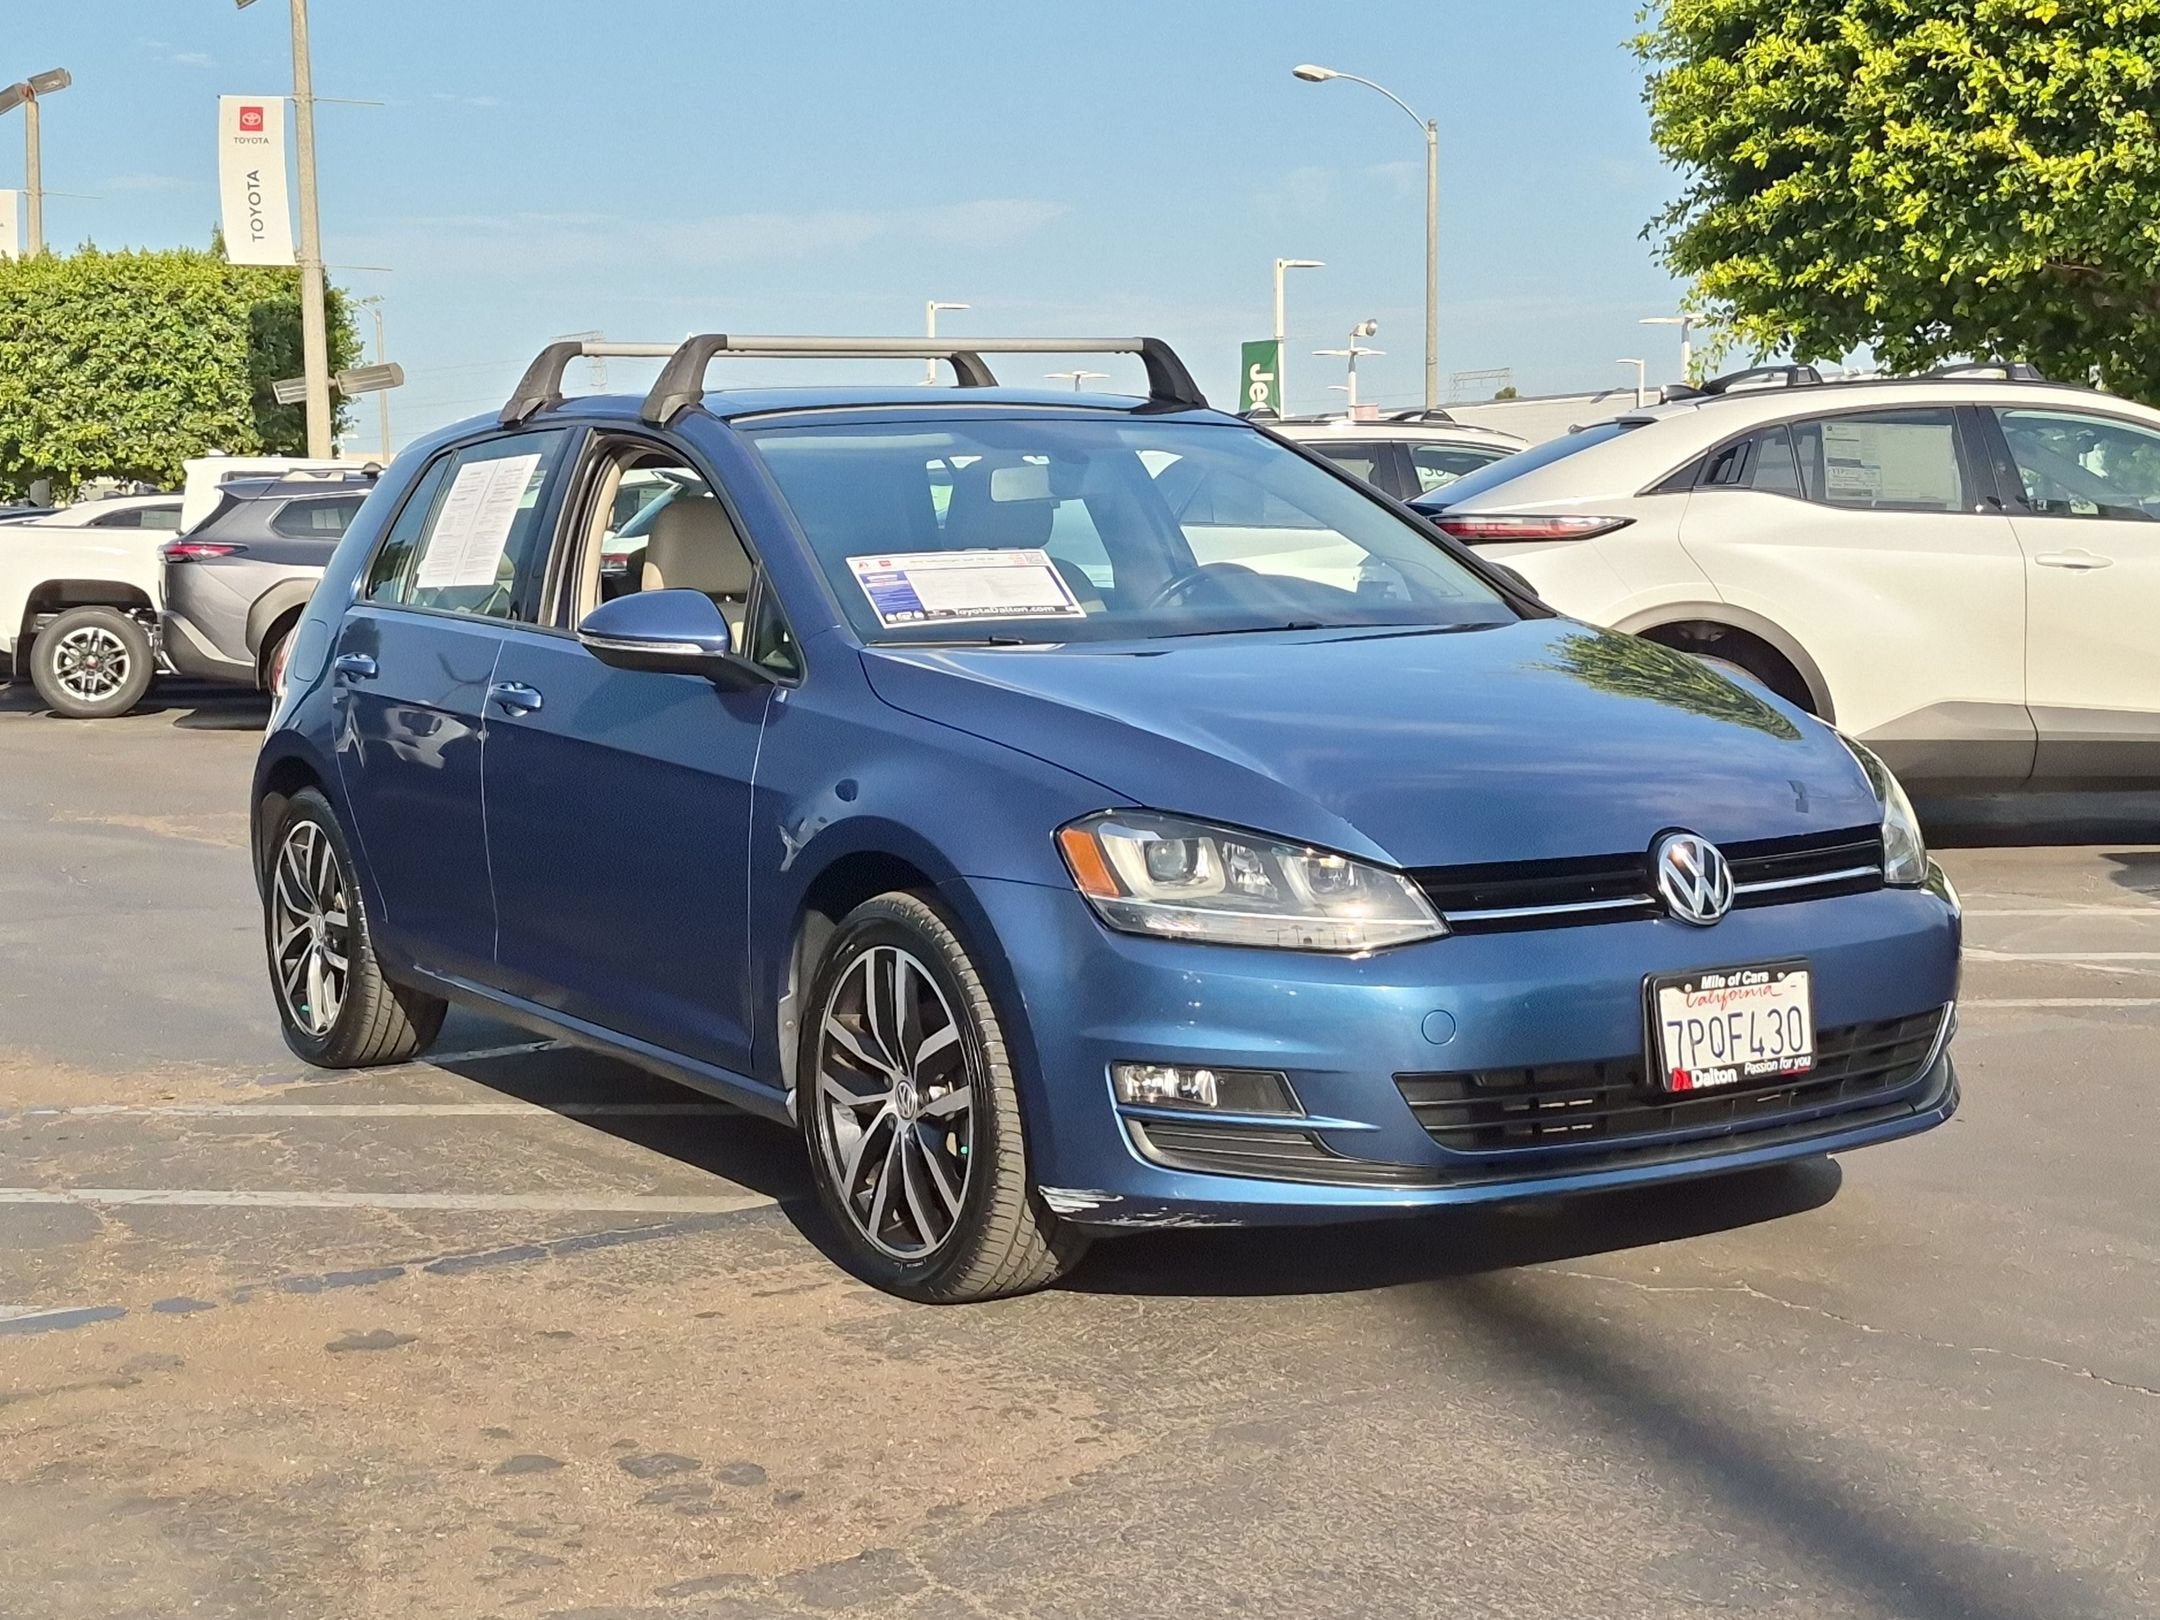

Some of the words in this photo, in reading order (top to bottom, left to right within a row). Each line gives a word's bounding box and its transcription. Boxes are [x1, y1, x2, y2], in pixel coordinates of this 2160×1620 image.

[247, 170, 265, 242] TOYOTA
[1727, 971, 1742, 987] of
[1742, 970, 1770, 986] Cars
[1686, 984, 1783, 1012] California
[1666, 1005, 1804, 1069] 7PQF430
[1691, 1067, 1738, 1089] Dalton
[1744, 1059, 1778, 1076] Passion
[1779, 1056, 1793, 1070] for
[1793, 1055, 1812, 1071] you
